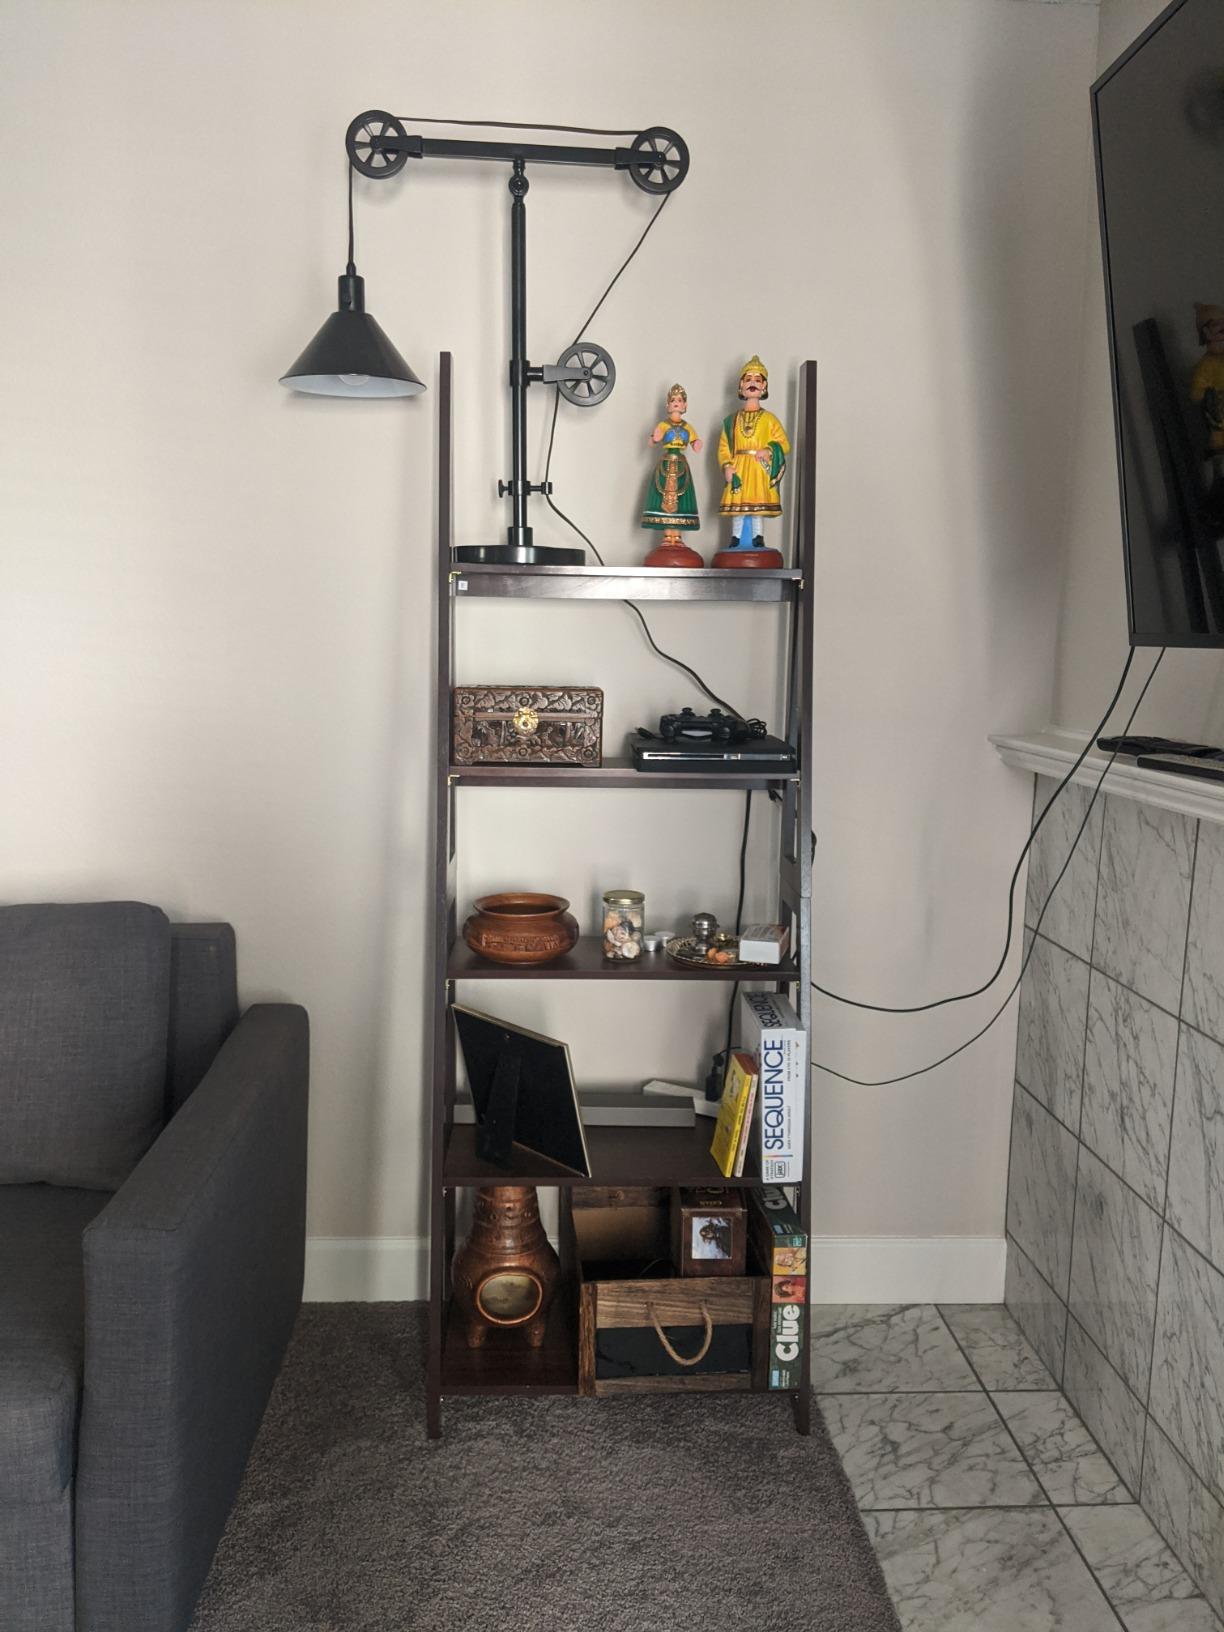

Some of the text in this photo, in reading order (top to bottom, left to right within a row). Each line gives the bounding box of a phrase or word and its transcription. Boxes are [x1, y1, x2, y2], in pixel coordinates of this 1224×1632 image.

[763, 1039, 784, 1150] SEQUENCE
[763, 1187, 787, 1209] Clu
[775, 1304, 800, 1362] Clue
